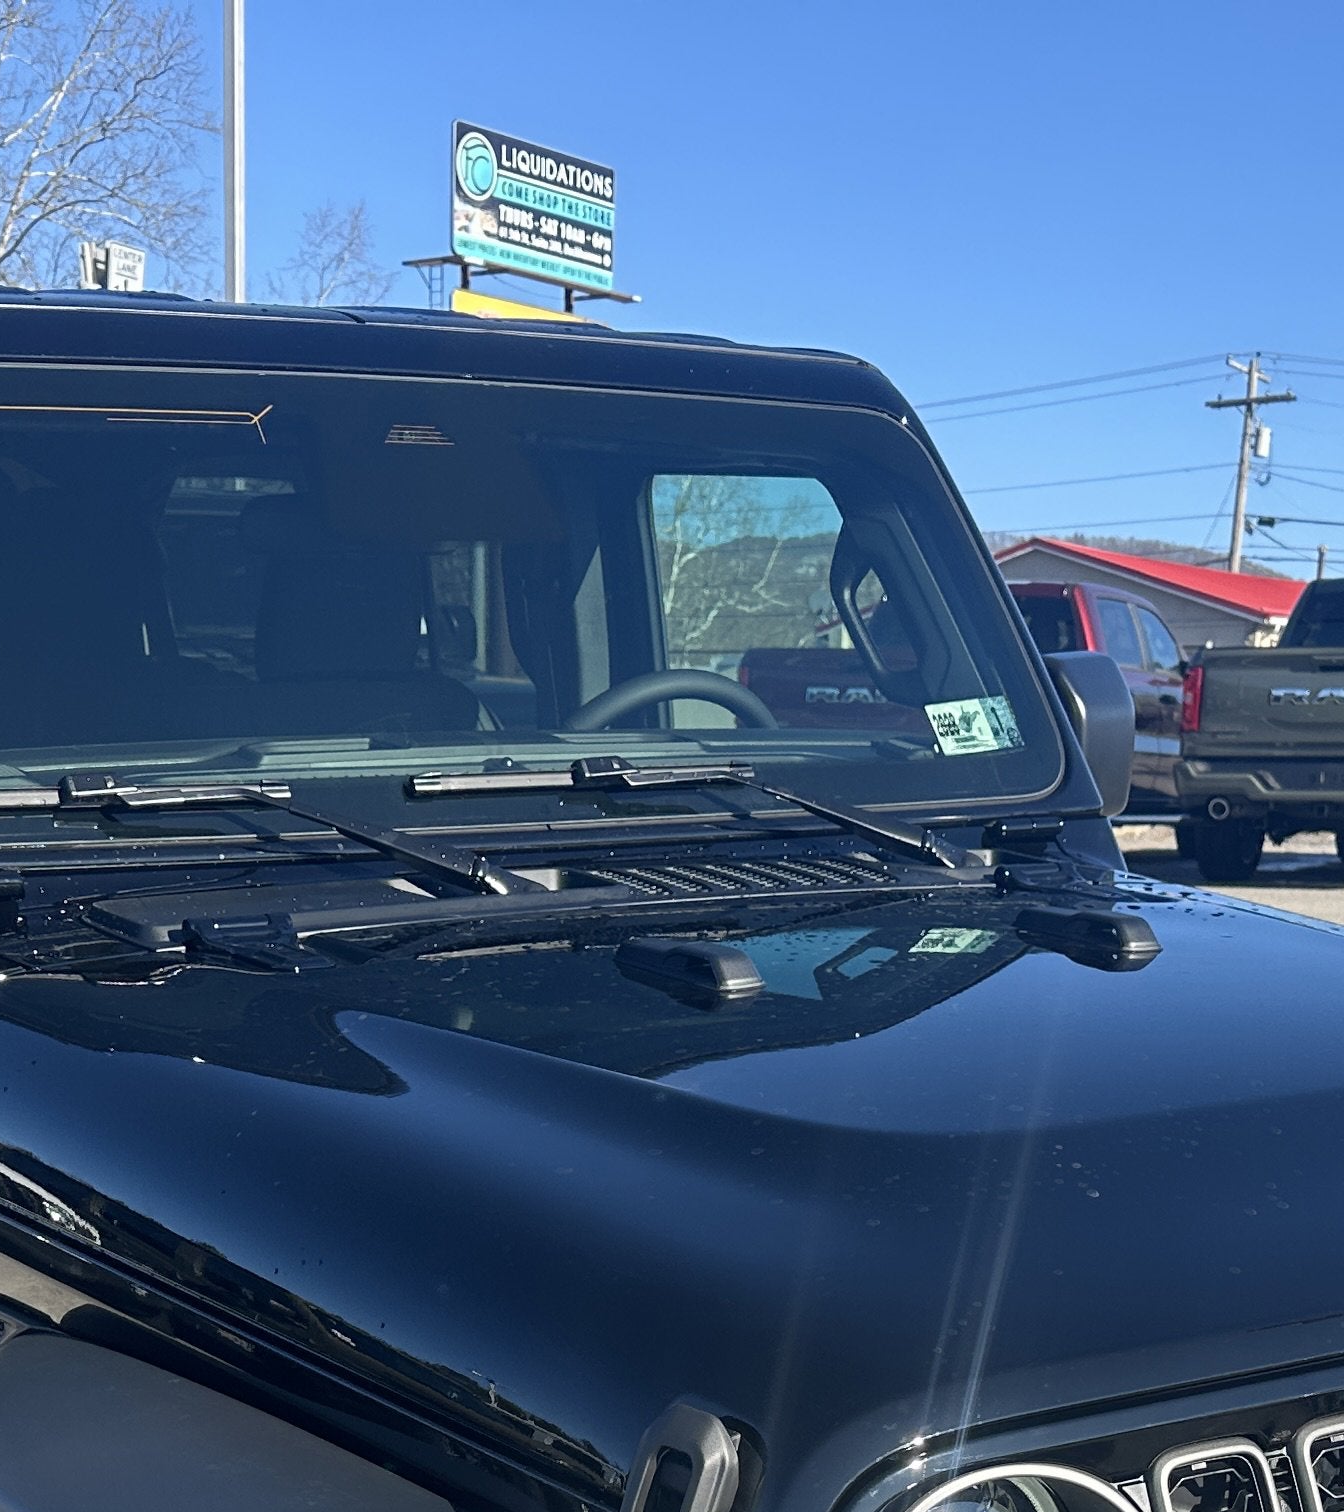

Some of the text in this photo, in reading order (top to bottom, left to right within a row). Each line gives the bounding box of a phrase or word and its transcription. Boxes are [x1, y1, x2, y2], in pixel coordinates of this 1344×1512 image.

[500, 144, 613, 199] LIQUIDATIONS
[498, 204, 534, 230] THURS
[539, 216, 559, 237] SAT
[501, 181, 611, 227] COME SHOP THE STORE
